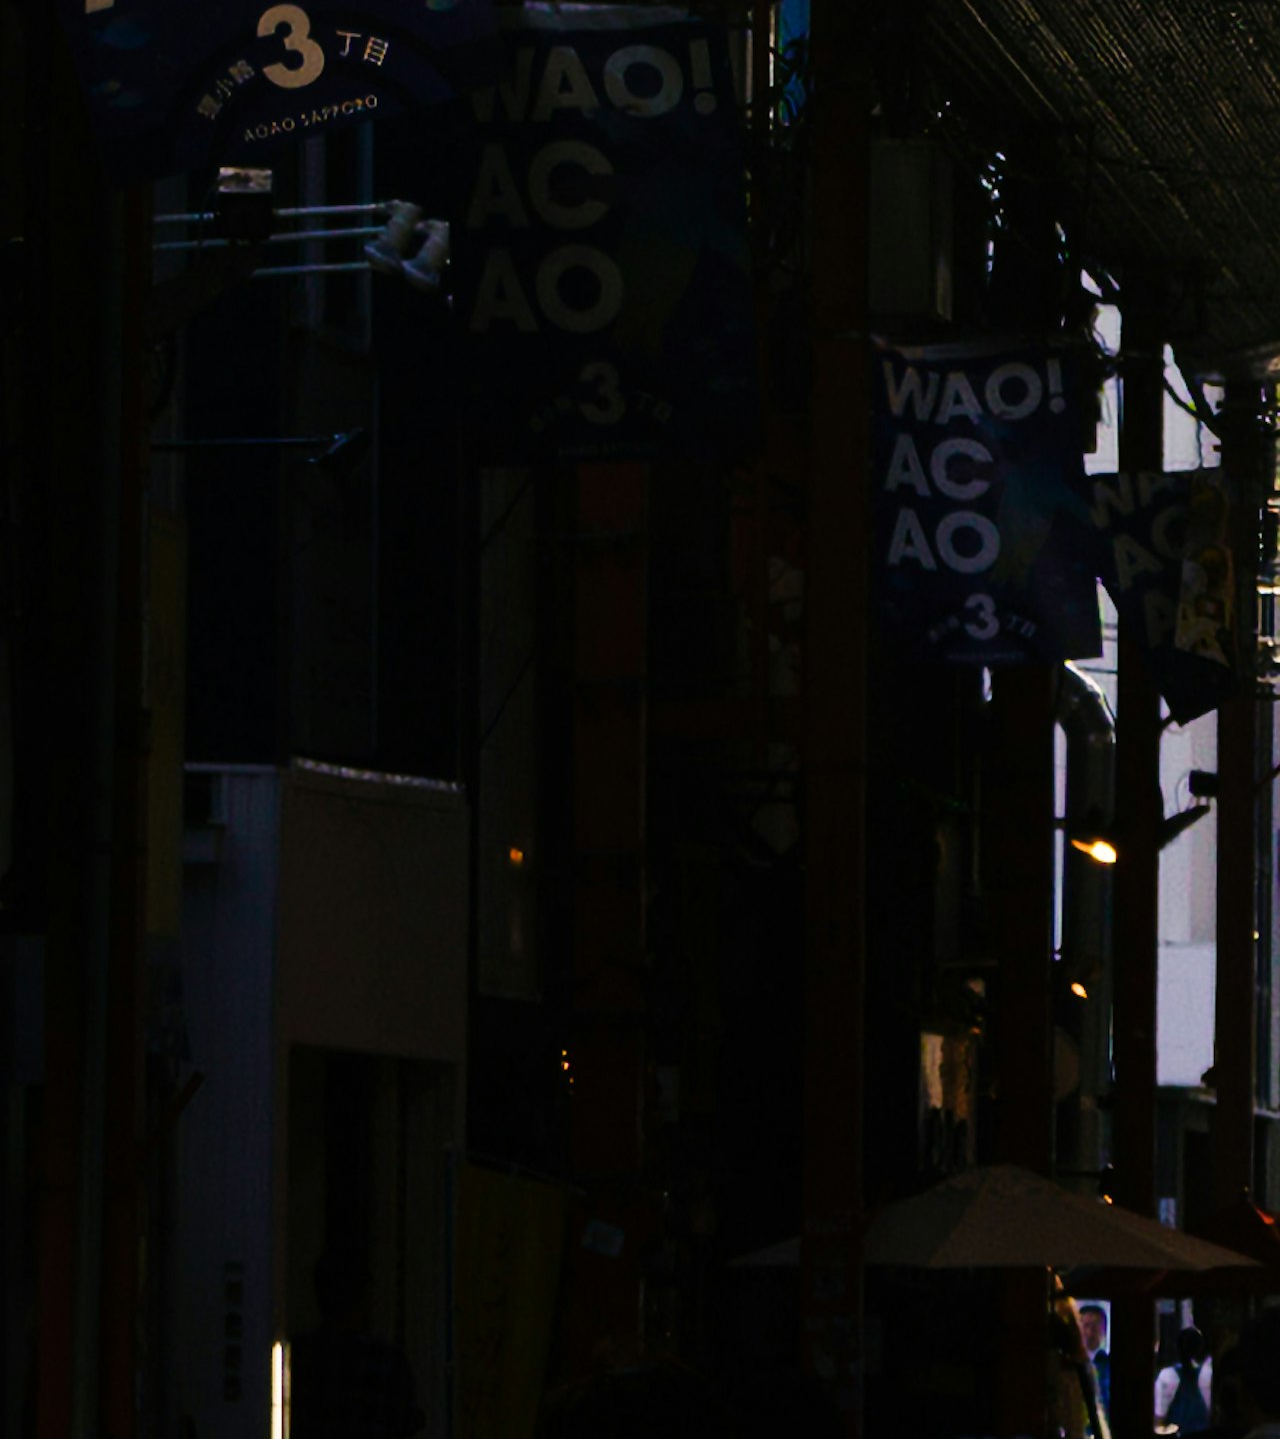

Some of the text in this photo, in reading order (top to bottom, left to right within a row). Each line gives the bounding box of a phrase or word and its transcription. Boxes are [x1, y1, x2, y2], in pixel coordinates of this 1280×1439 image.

[256, 3, 326, 90] 3
[243, 117, 296, 142] AOAO
[464, 138, 616, 230] AC
[467, 243, 625, 335] AO
[881, 357, 1066, 426] WAO!
[883, 433, 995, 501] AC
[886, 506, 1001, 575] AO
